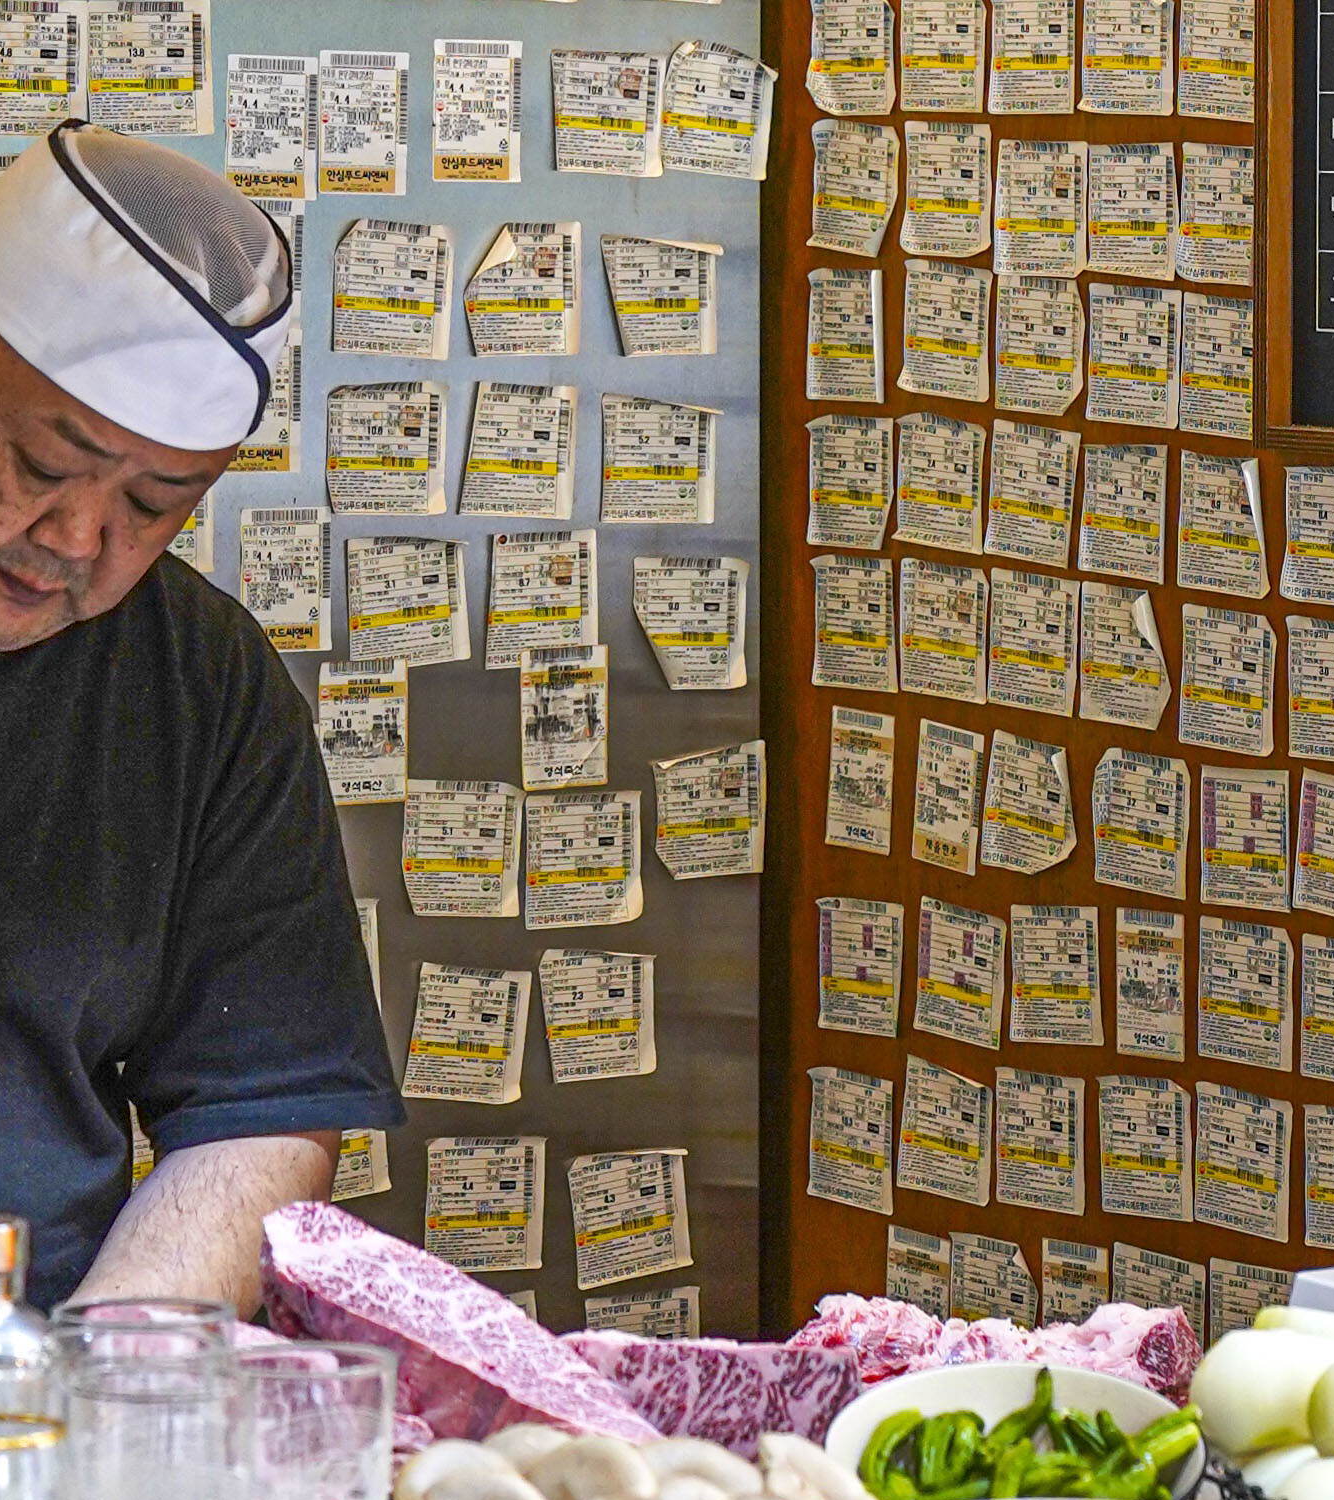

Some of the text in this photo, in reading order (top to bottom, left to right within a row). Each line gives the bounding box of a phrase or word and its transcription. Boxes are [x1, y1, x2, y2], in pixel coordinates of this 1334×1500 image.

[441, 156, 503, 169] 안심푸드씨앤씨
[233, 174, 297, 187] 안심푸드씨앤씨
[327, 170, 389, 182] 안심푸드씨앤씨
